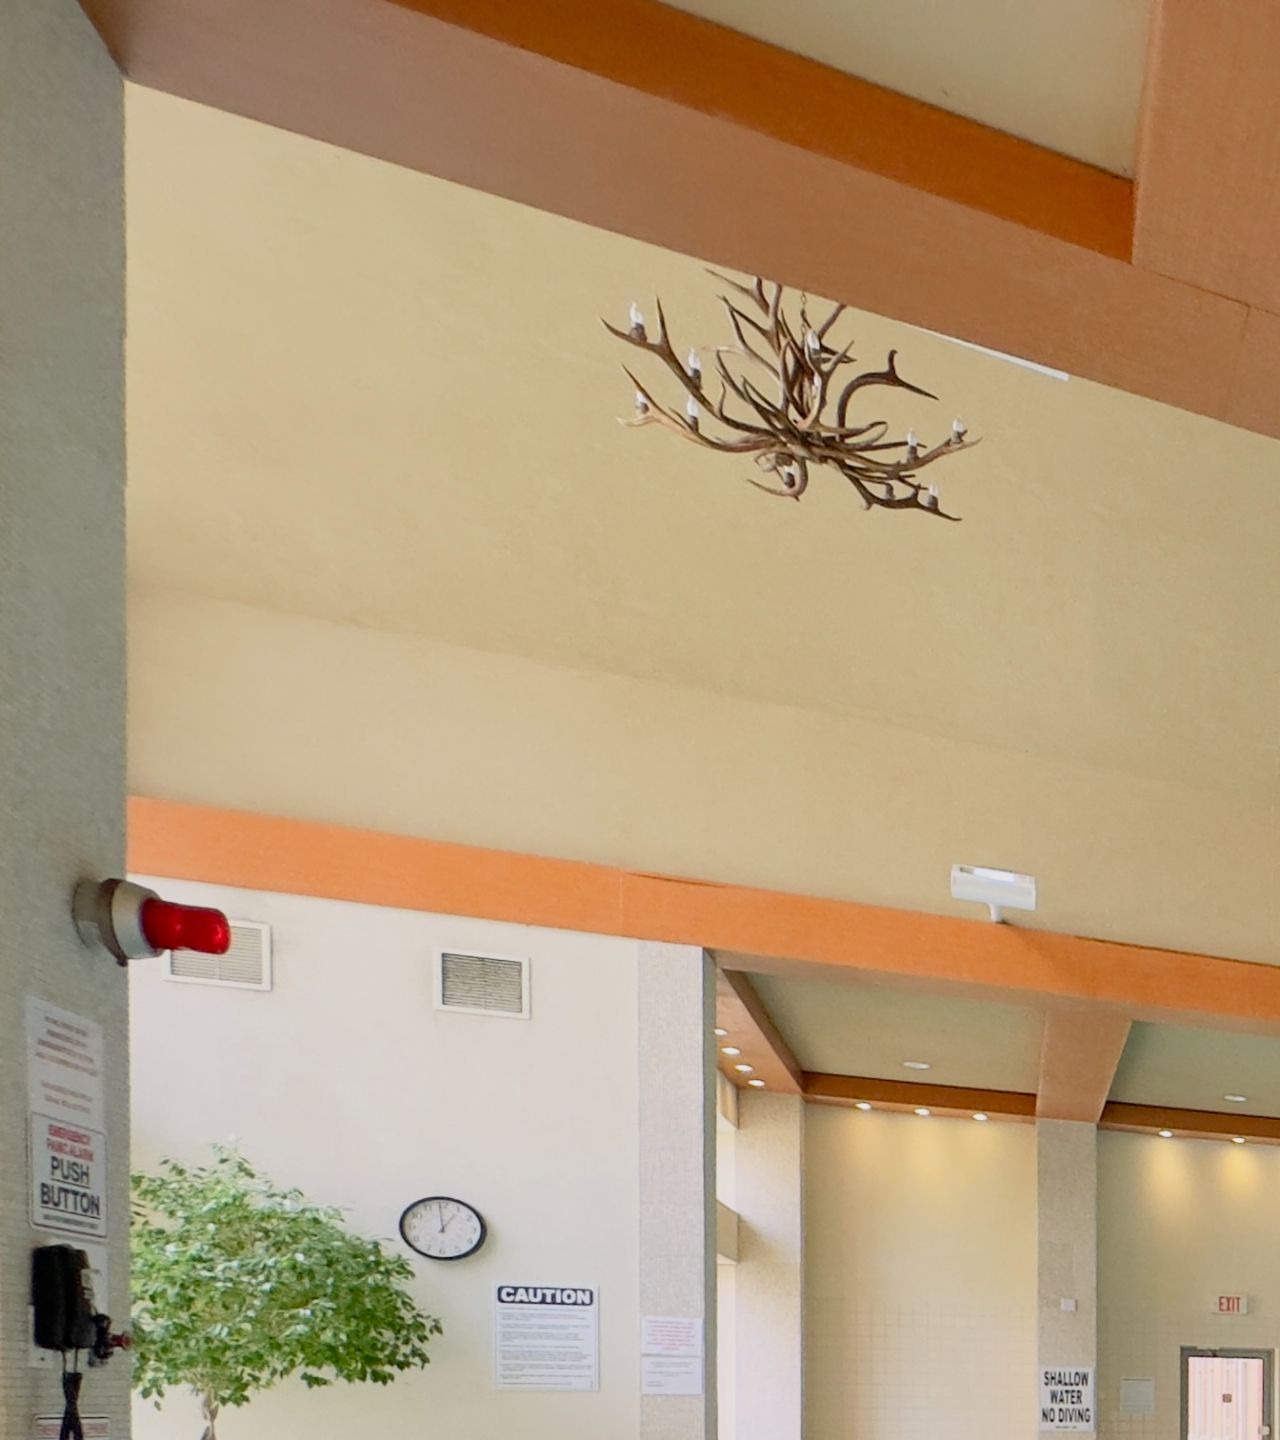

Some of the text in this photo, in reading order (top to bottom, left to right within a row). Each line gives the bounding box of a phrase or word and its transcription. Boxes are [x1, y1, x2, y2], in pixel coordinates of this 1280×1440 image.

[51, 1156, 90, 1185] PUSH
[41, 1182, 100, 1216] BUTTON
[500, 1287, 591, 1304] CAUTION
[1219, 1296, 1240, 1312] EXIT
[1044, 1371, 1089, 1386] SHALLOW
[1050, 1390, 1082, 1404] WATER
[1042, 1408, 1091, 1422] NO DIVING
